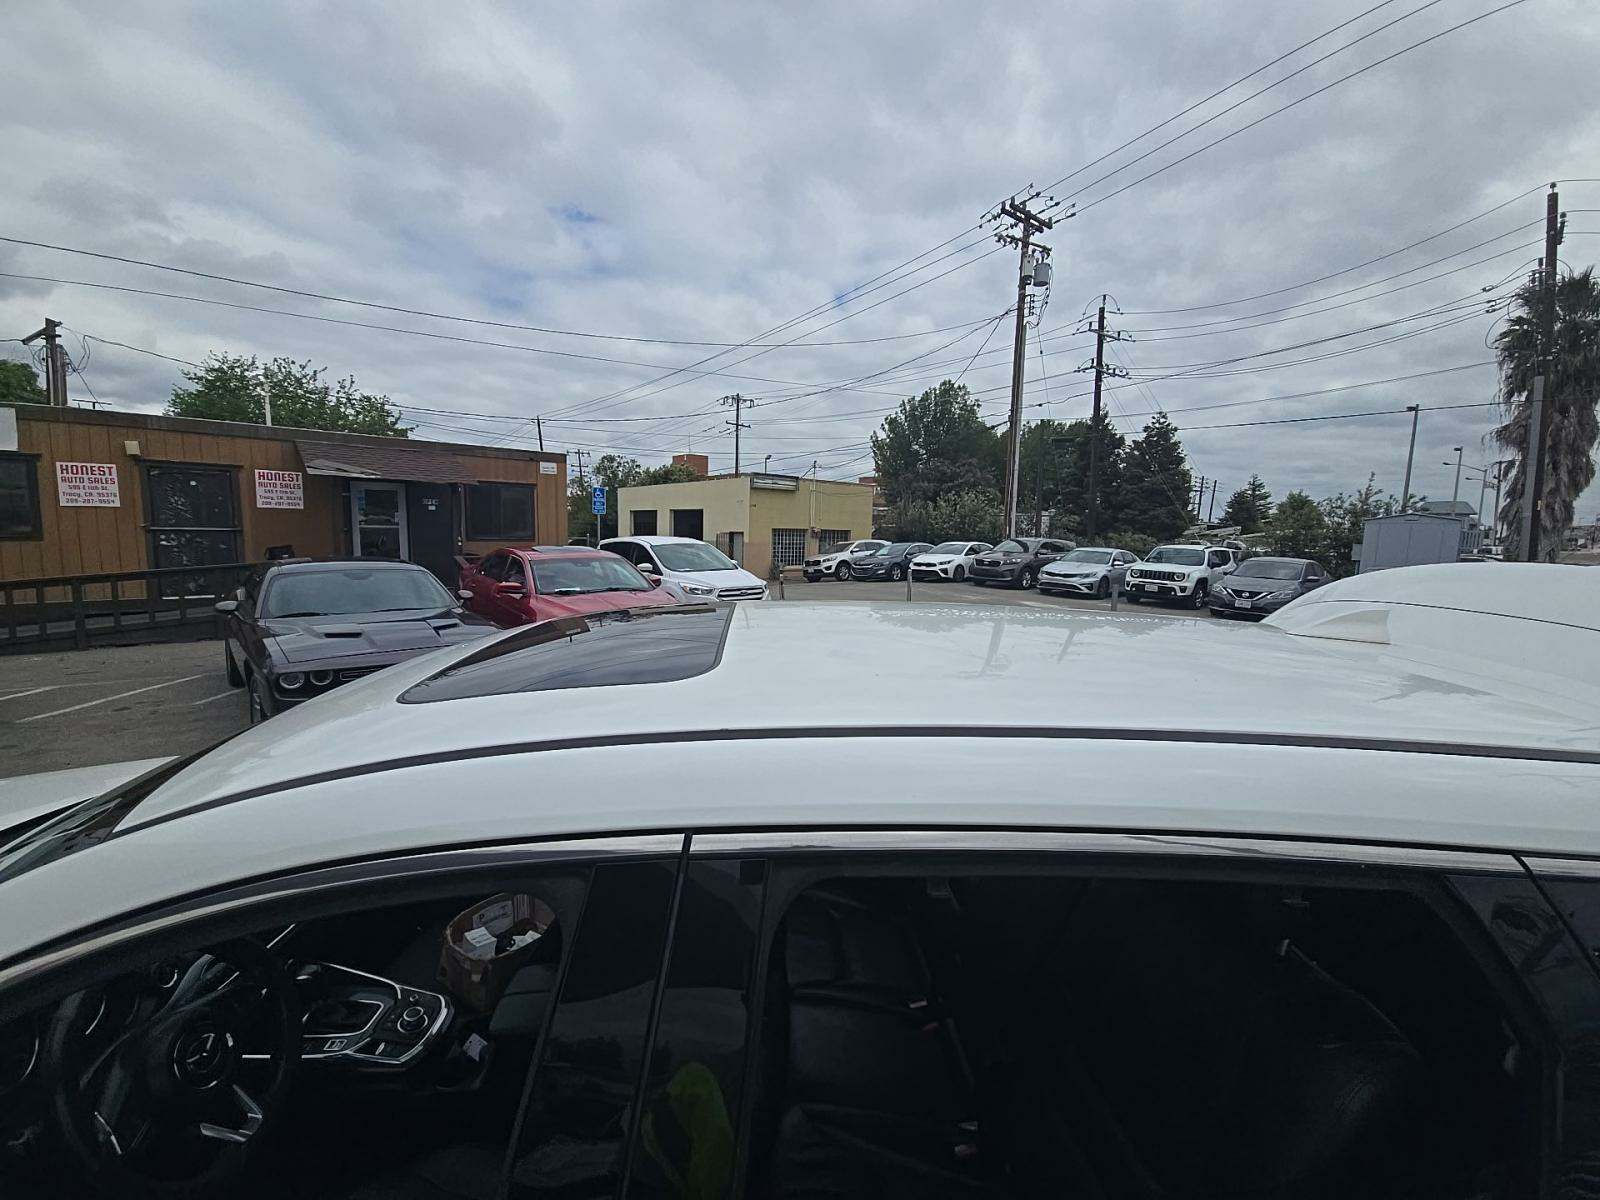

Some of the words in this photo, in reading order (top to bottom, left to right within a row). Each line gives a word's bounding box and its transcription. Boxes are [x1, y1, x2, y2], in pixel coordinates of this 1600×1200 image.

[60, 464, 113, 476] HONEST
[60, 476, 85, 484] AUTO
[87, 477, 116, 485] SALES
[258, 471, 300, 482] HONEST
